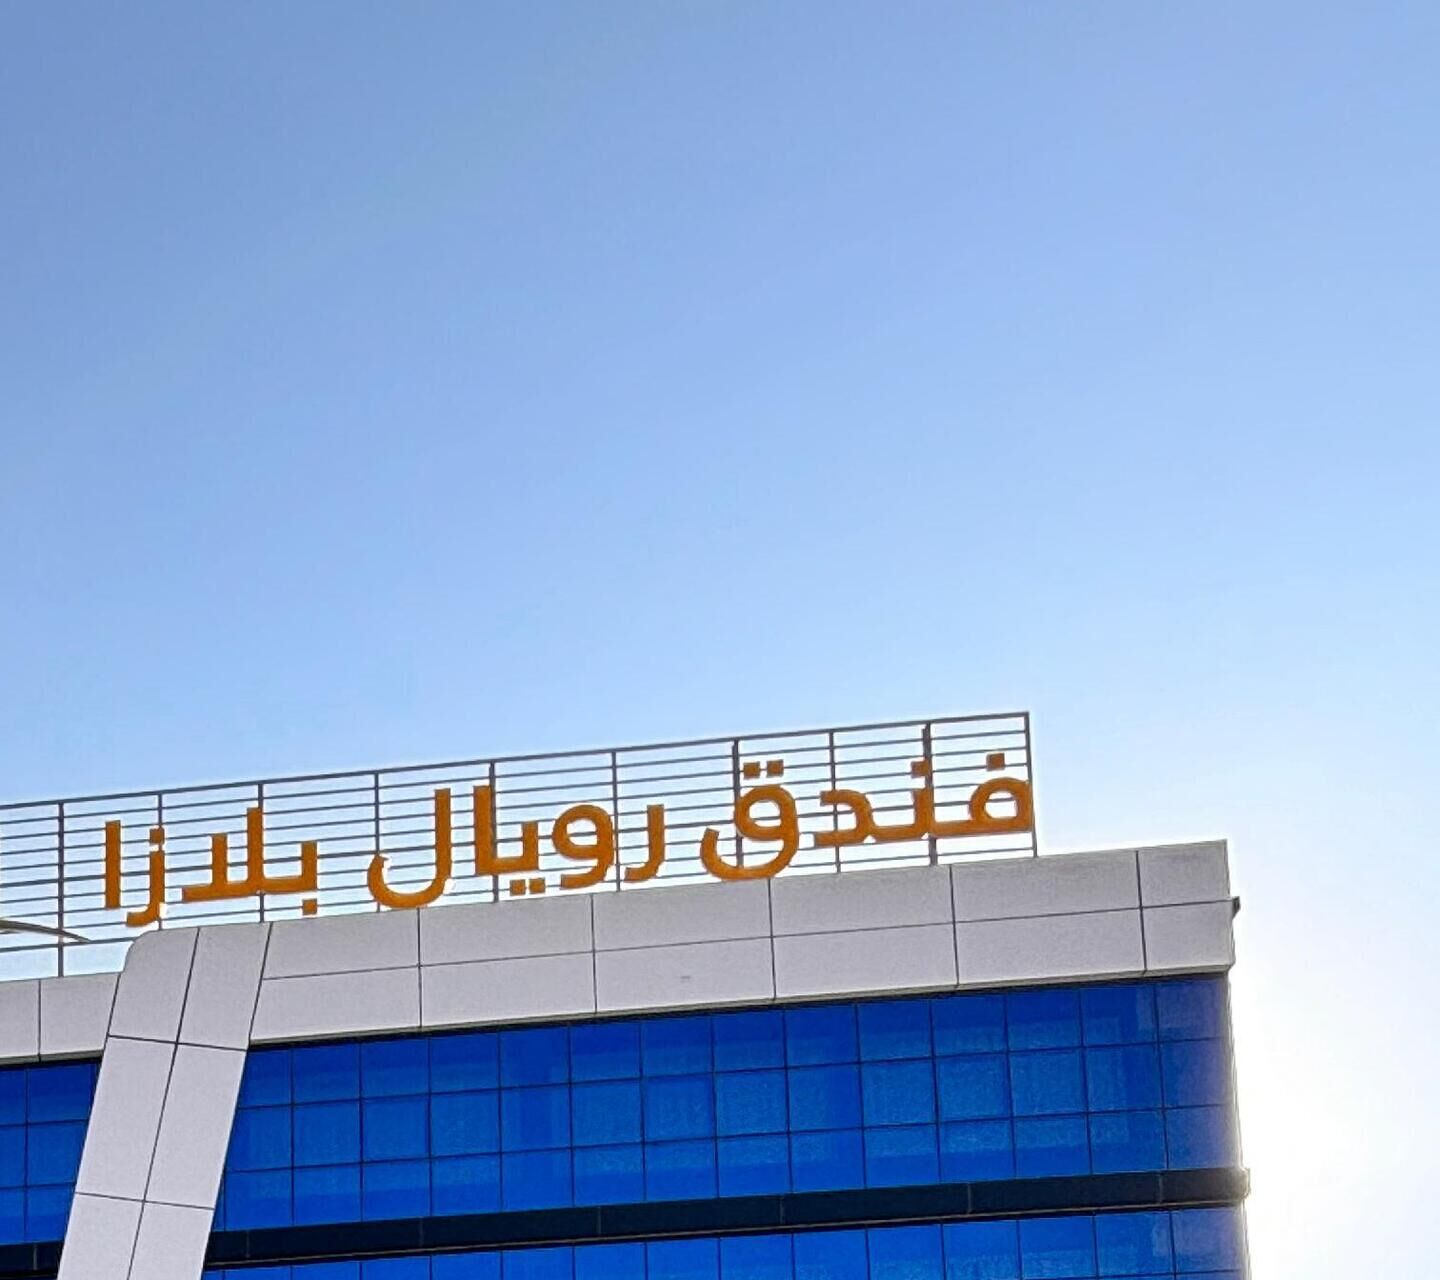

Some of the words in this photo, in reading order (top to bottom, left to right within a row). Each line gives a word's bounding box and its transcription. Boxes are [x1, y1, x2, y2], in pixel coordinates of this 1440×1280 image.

[105, 806, 318, 927] بلازا
[367, 784, 665, 909] رويال
[700, 752, 1034, 881] فندق
